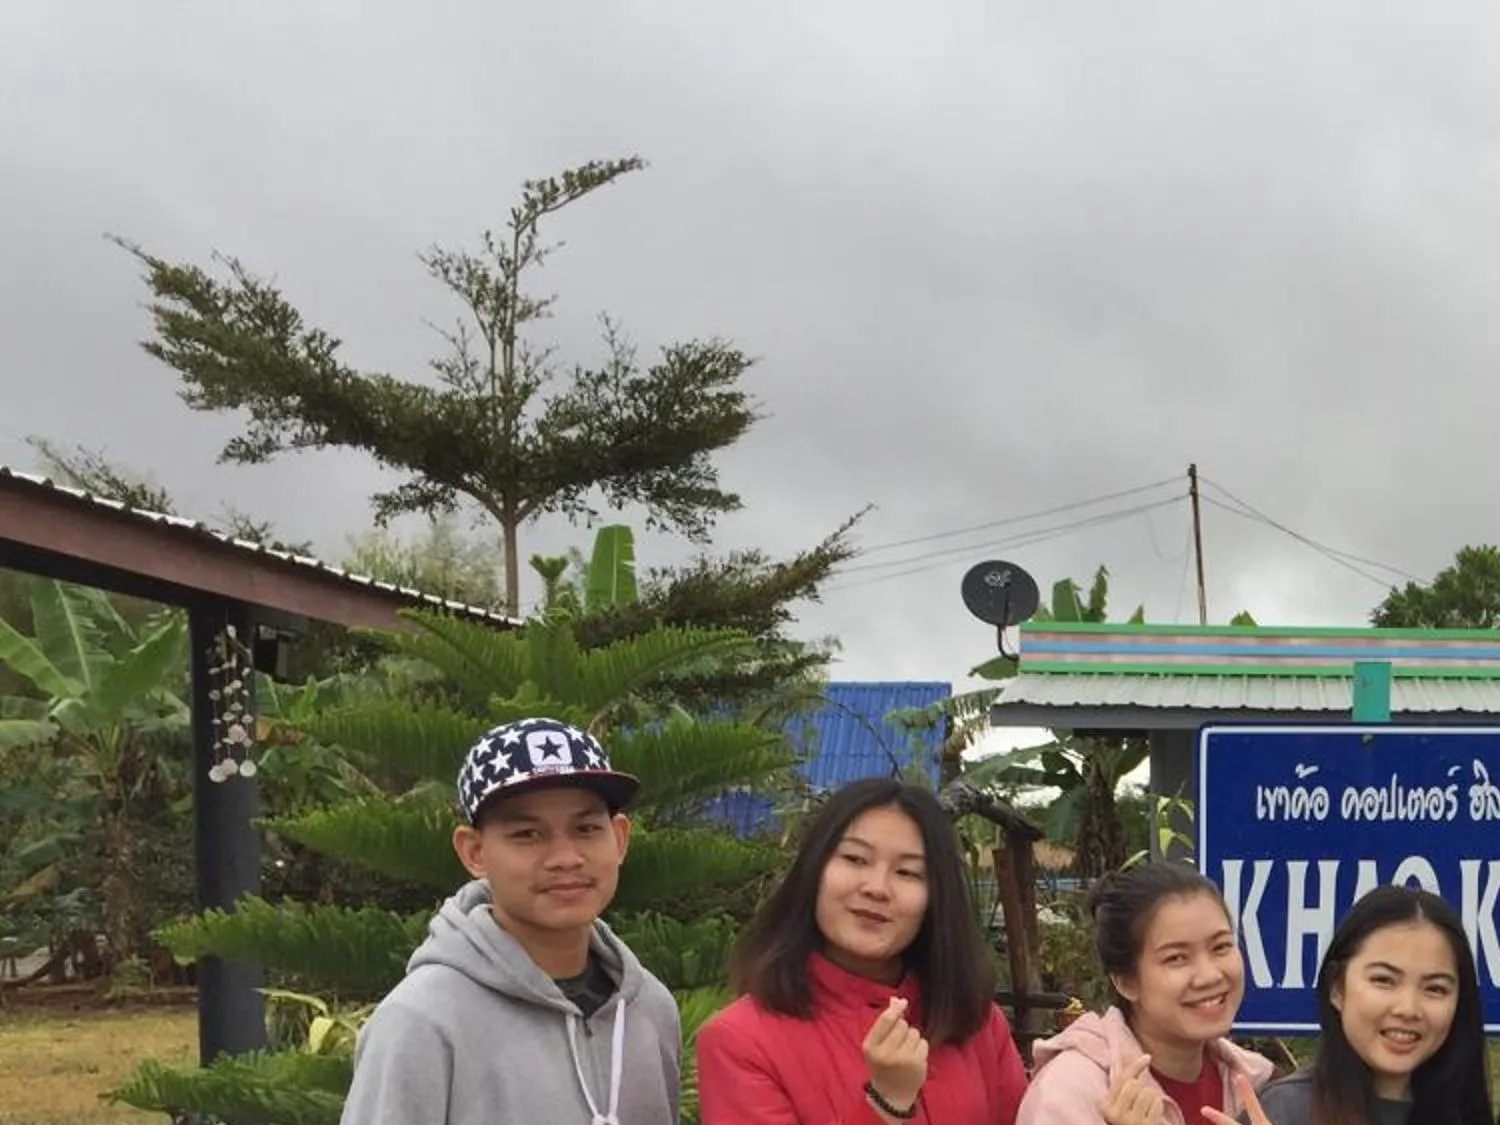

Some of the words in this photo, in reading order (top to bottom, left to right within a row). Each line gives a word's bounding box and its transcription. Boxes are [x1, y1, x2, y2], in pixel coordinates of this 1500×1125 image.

[1256, 763, 1330, 821] เขาค้อ
[1341, 765, 1462, 821] คอปเตอร์
[1221, 855, 1441, 989] KH
